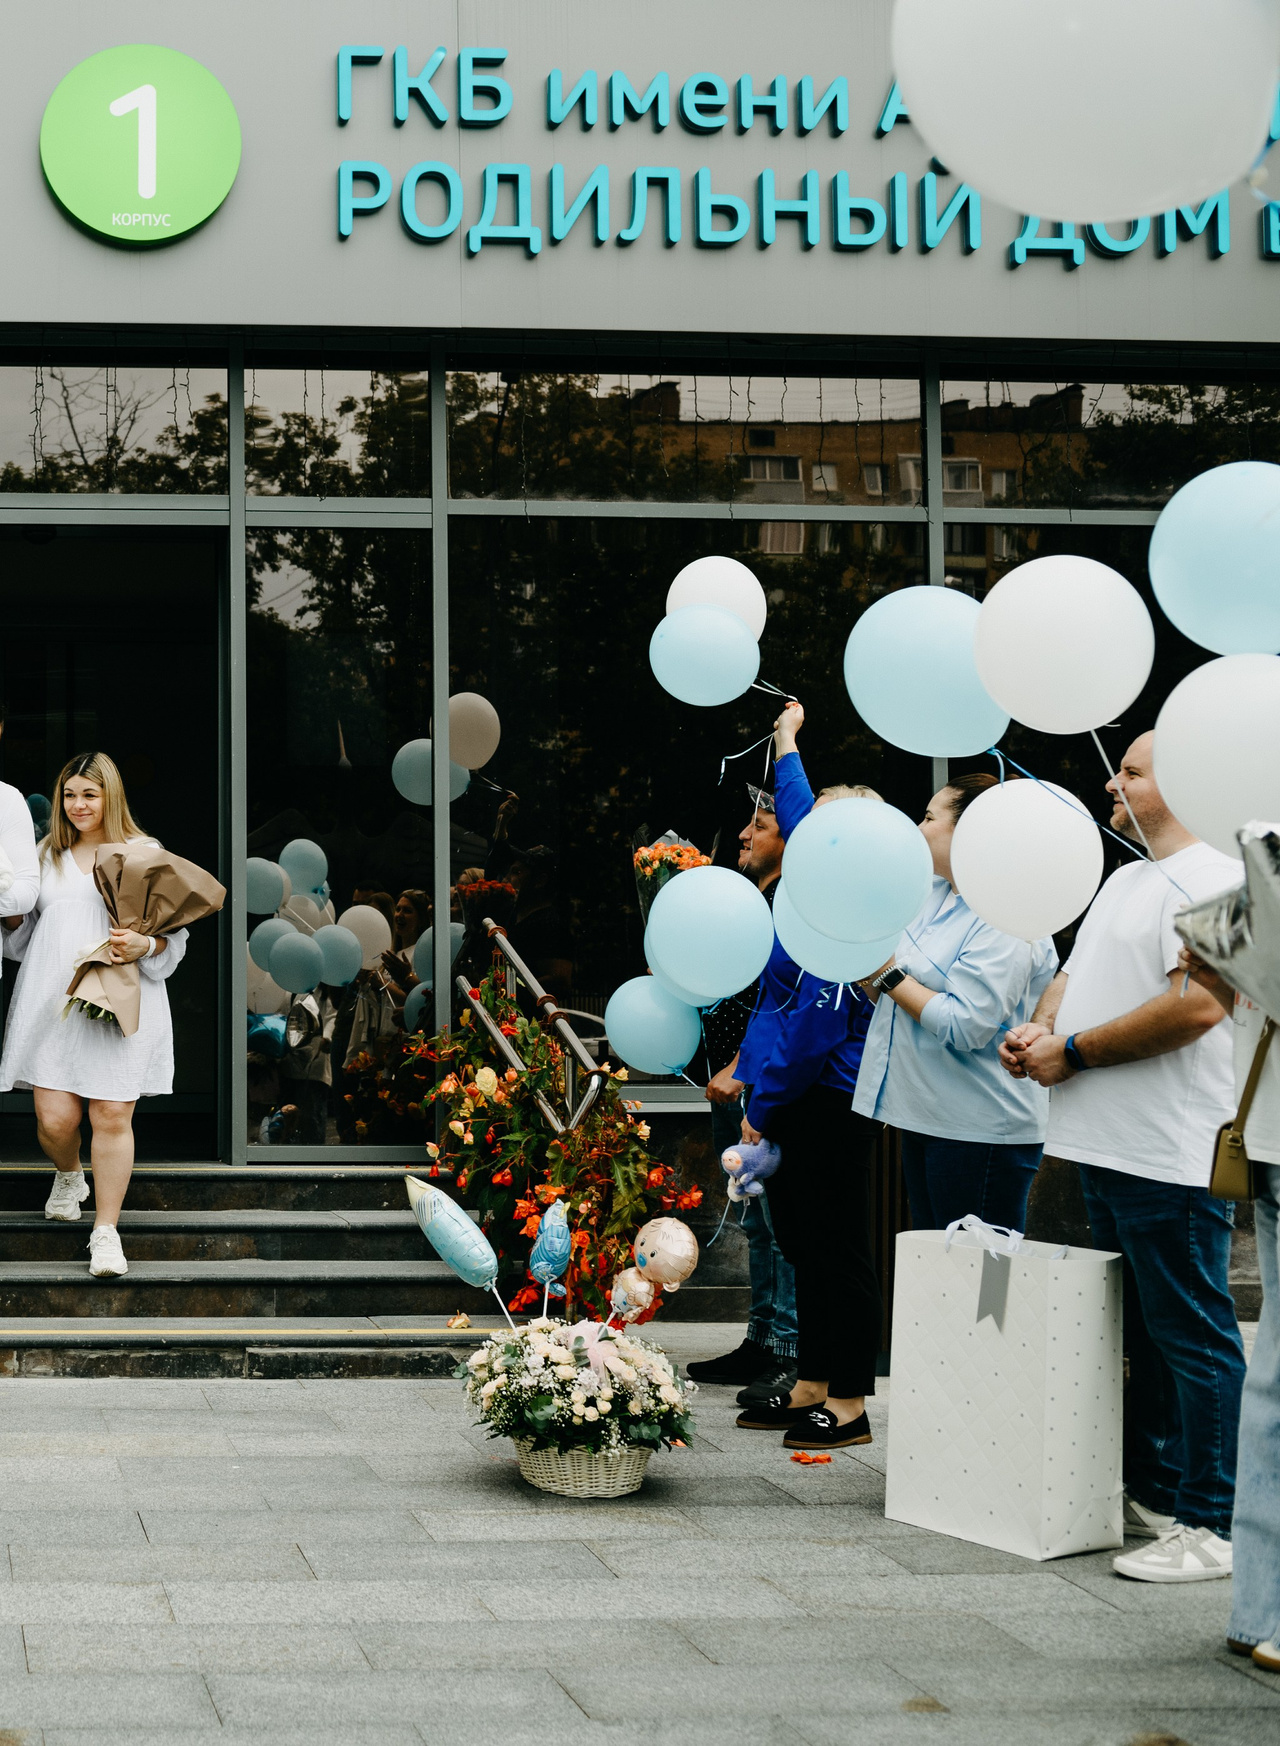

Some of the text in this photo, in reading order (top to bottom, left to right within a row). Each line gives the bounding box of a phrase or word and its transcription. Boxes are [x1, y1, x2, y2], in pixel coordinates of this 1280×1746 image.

[337, 45, 514, 128] ГКБ
[547, 67, 848, 133] имени
[109, 84, 157, 199] 1
[112, 213, 171, 227] КОРПУС
[337, 155, 982, 256] РОДИЛЬНЫЙ
